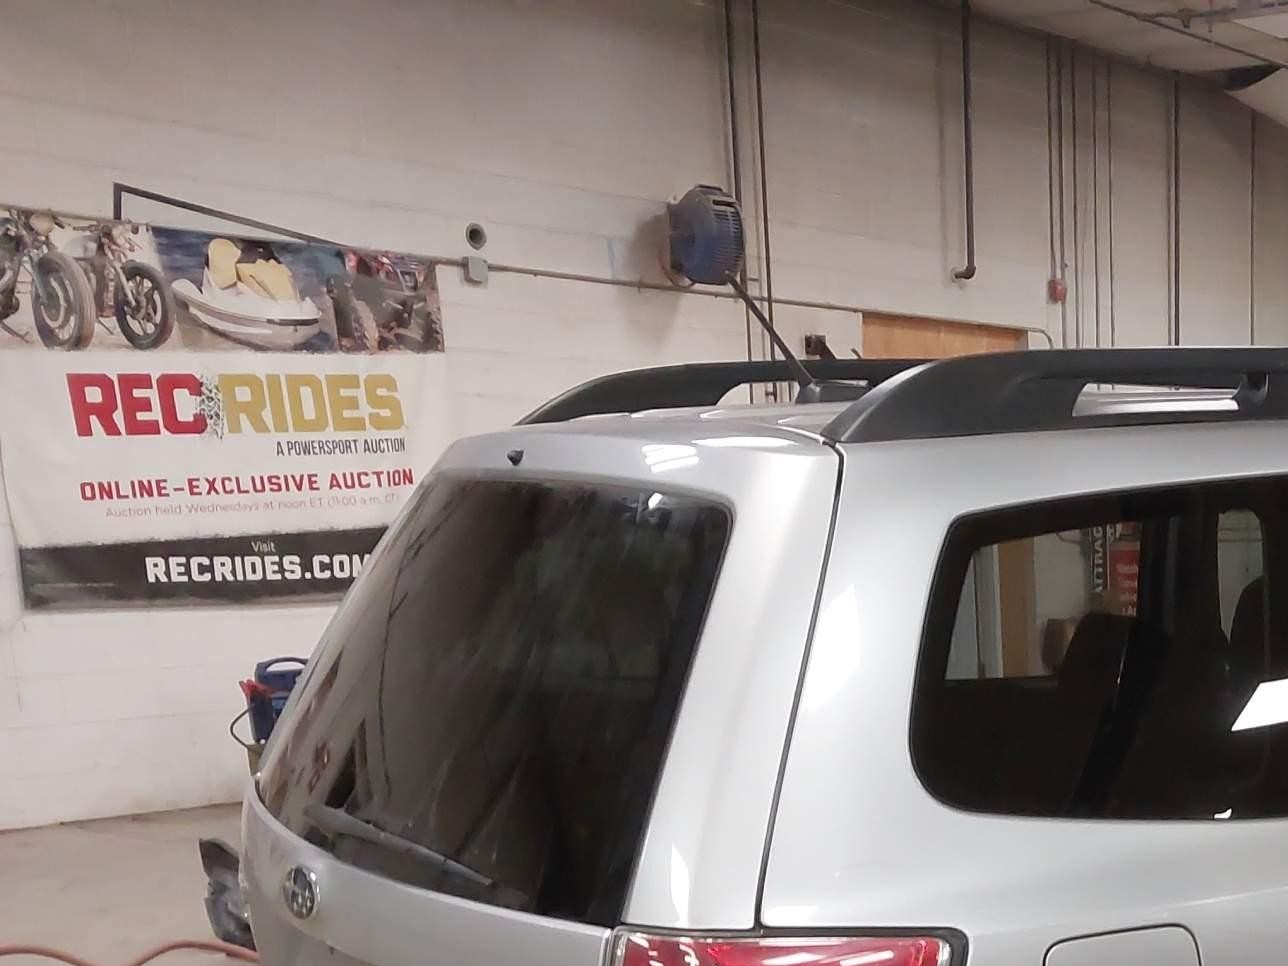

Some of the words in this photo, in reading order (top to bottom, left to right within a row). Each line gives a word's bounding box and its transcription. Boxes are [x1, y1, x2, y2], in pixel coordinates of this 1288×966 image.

[276, 441, 285, 457] A
[286, 439, 360, 457] POWERSPORT
[363, 437, 406, 454] AUCTION
[329, 468, 413, 491] AUCTION
[105, 505, 151, 518] Auction
[155, 503, 182, 516] held
[185, 501, 259, 514] Wednesdays
[263, 500, 275, 510] at
[278, 500, 306, 510] noon
[251, 540, 277, 553] Visit
